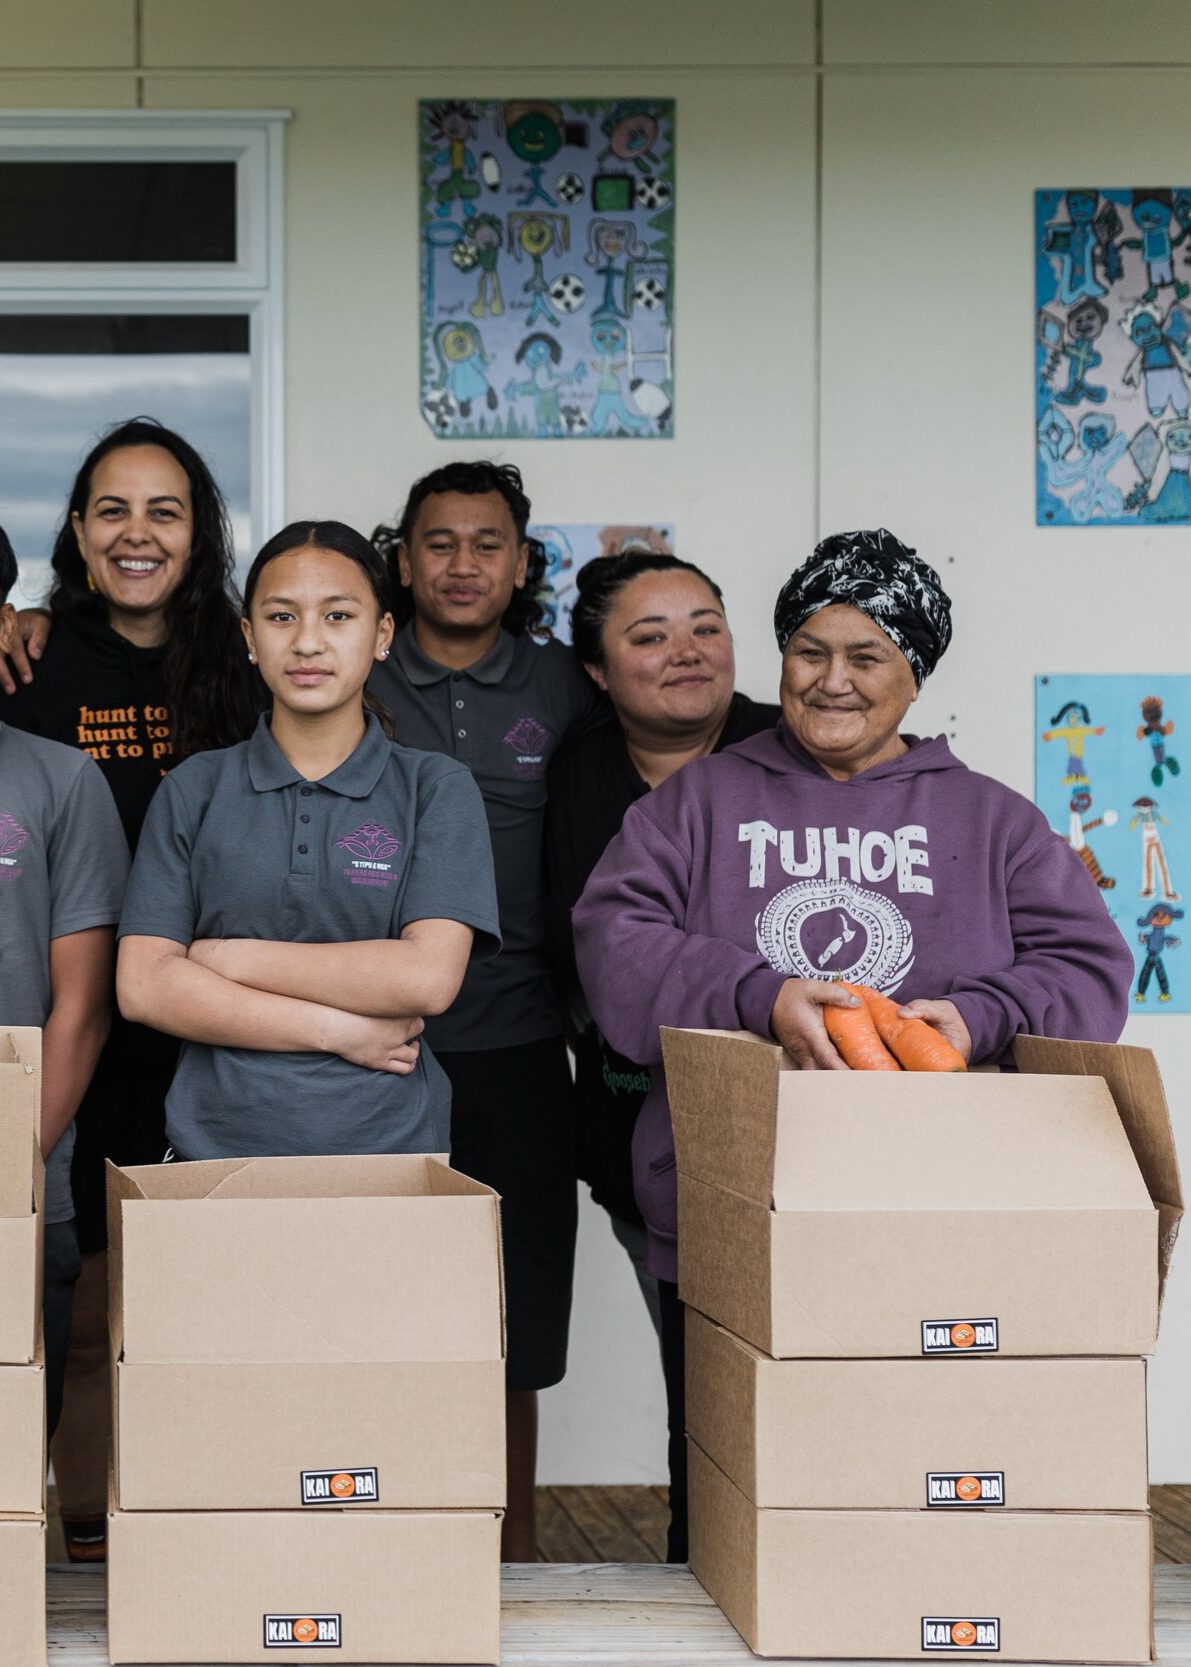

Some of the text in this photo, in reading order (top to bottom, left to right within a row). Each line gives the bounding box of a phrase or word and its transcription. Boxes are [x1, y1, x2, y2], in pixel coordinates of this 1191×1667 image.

[79, 704, 168, 724] hunt to
[77, 725, 169, 743] hunt to
[116, 742, 143, 758] to
[738, 820, 934, 896] TUHOE
